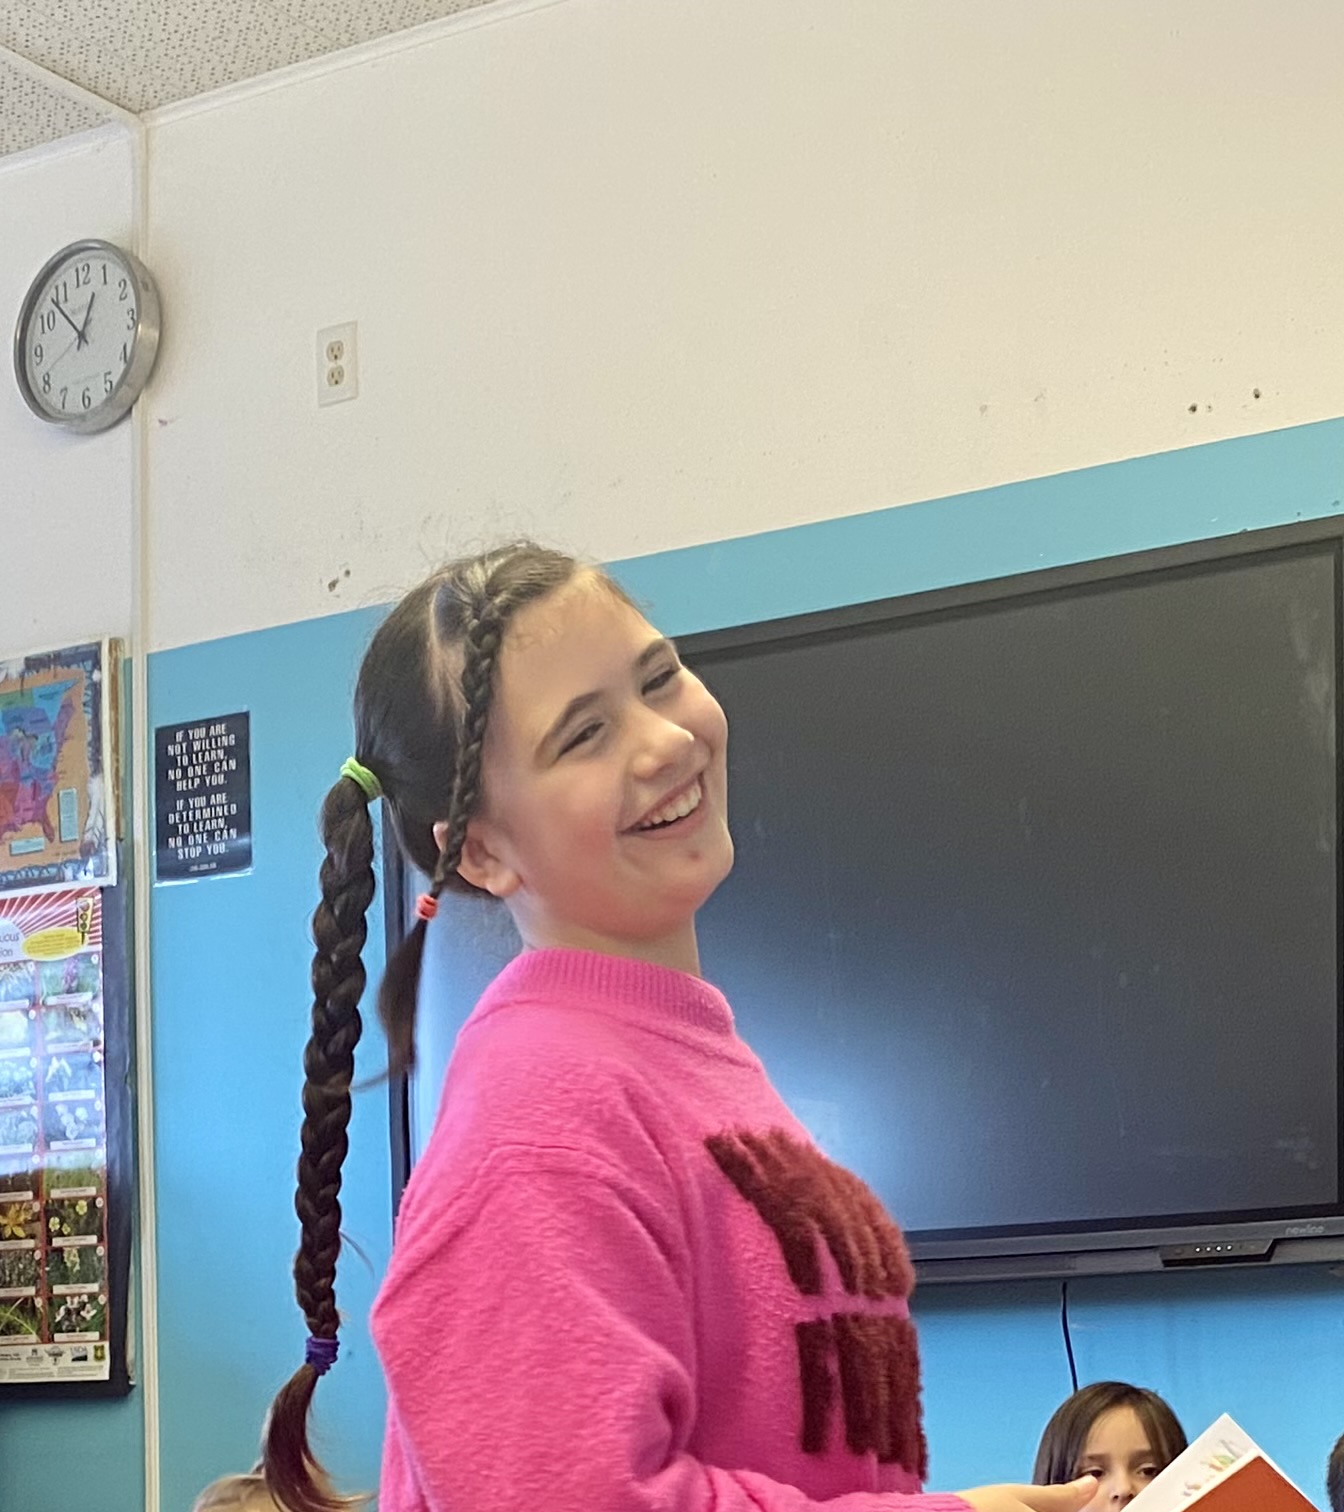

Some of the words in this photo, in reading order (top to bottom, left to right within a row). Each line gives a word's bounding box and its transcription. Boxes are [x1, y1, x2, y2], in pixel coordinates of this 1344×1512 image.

[74, 263, 91, 288] 12
[101, 264, 108, 285] 1
[55, 281, 68, 305] 11
[118, 278, 128, 301] 2
[40, 310, 56, 334] 10
[127, 308, 136, 331] 3
[34, 343, 43, 365] 9
[120, 342, 128, 364] 4
[42, 372, 51, 394] 8
[103, 371, 113, 393] 5
[60, 386, 68, 410] 7
[82, 387, 91, 409] 6
[176, 730, 183, 743] IF
[188, 727, 205, 740] YOU
[209, 723, 226, 736] ARE
[167, 743, 187, 756] NOT
[192, 734, 235, 751] WILLING
[176, 755, 189, 767] TO
[192, 749, 227, 764] LEARN,
[168, 769, 182, 781] NO
[188, 765, 207, 777] ONE
[214, 759, 236, 773] CAN
[176, 778, 200, 791] HELP
[205, 774, 227, 787] YOU.
[176, 799, 183, 811] IF
[189, 796, 206, 809] YOU
[210, 793, 227, 804] ARE
[168, 803, 237, 825] DETERMINED
[177, 823, 189, 835] TO
[193, 818, 228, 833] LEARN,
[168, 837, 183, 849] NO
[188, 834, 208, 845] ONE
[214, 828, 237, 841] CAN
[177, 846, 202, 860] STOP
[207, 842, 229, 855] YOU.
